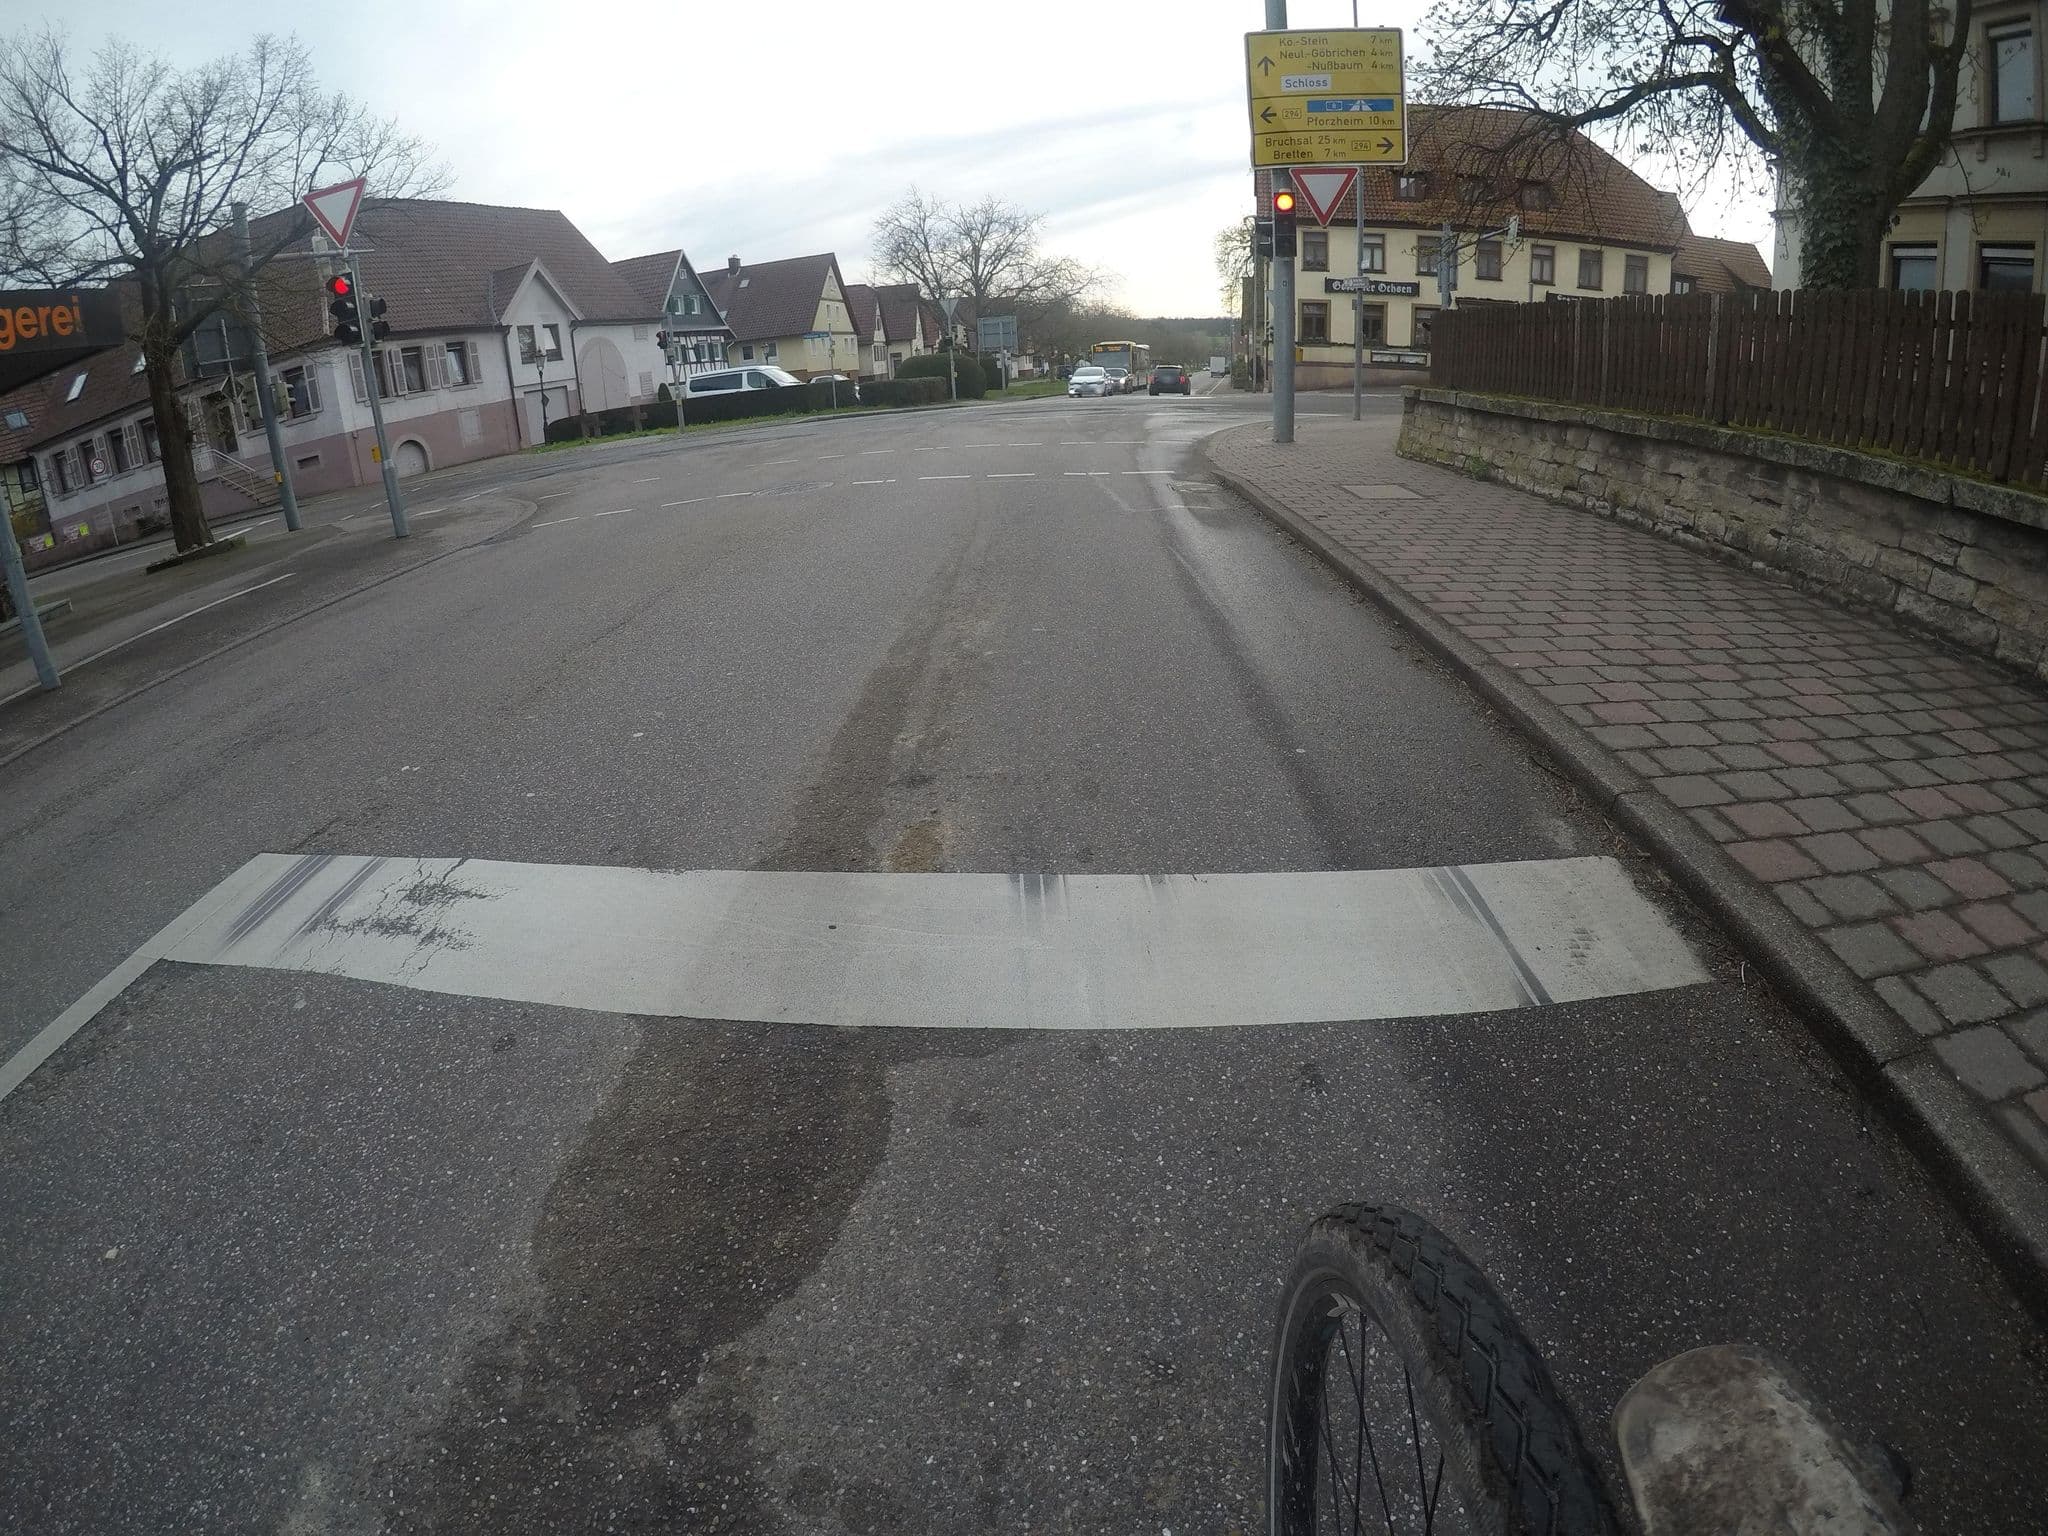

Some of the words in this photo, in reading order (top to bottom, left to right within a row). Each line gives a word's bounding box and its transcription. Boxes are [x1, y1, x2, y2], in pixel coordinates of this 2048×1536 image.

[1370, 35, 1377, 45] 7
[1371, 48, 1378, 57] 4
[1371, 60, 1378, 69] 4
[1285, 79, 1328, 89] Schloss
[1284, 110, 1300, 119] 294
[1307, 117, 1363, 127] Pforzheim
[1369, 116, 1380, 126] 10
[1382, 118, 1395, 126] km
[1265, 137, 1313, 147] Bruchsal
[1318, 136, 1331, 145] 25
[1354, 142, 1369, 150] 294
[1273, 150, 1314, 160] Bretten
[1324, 149, 1331, 158] 7
[1378, 283, 1412, 294] Ochsen
